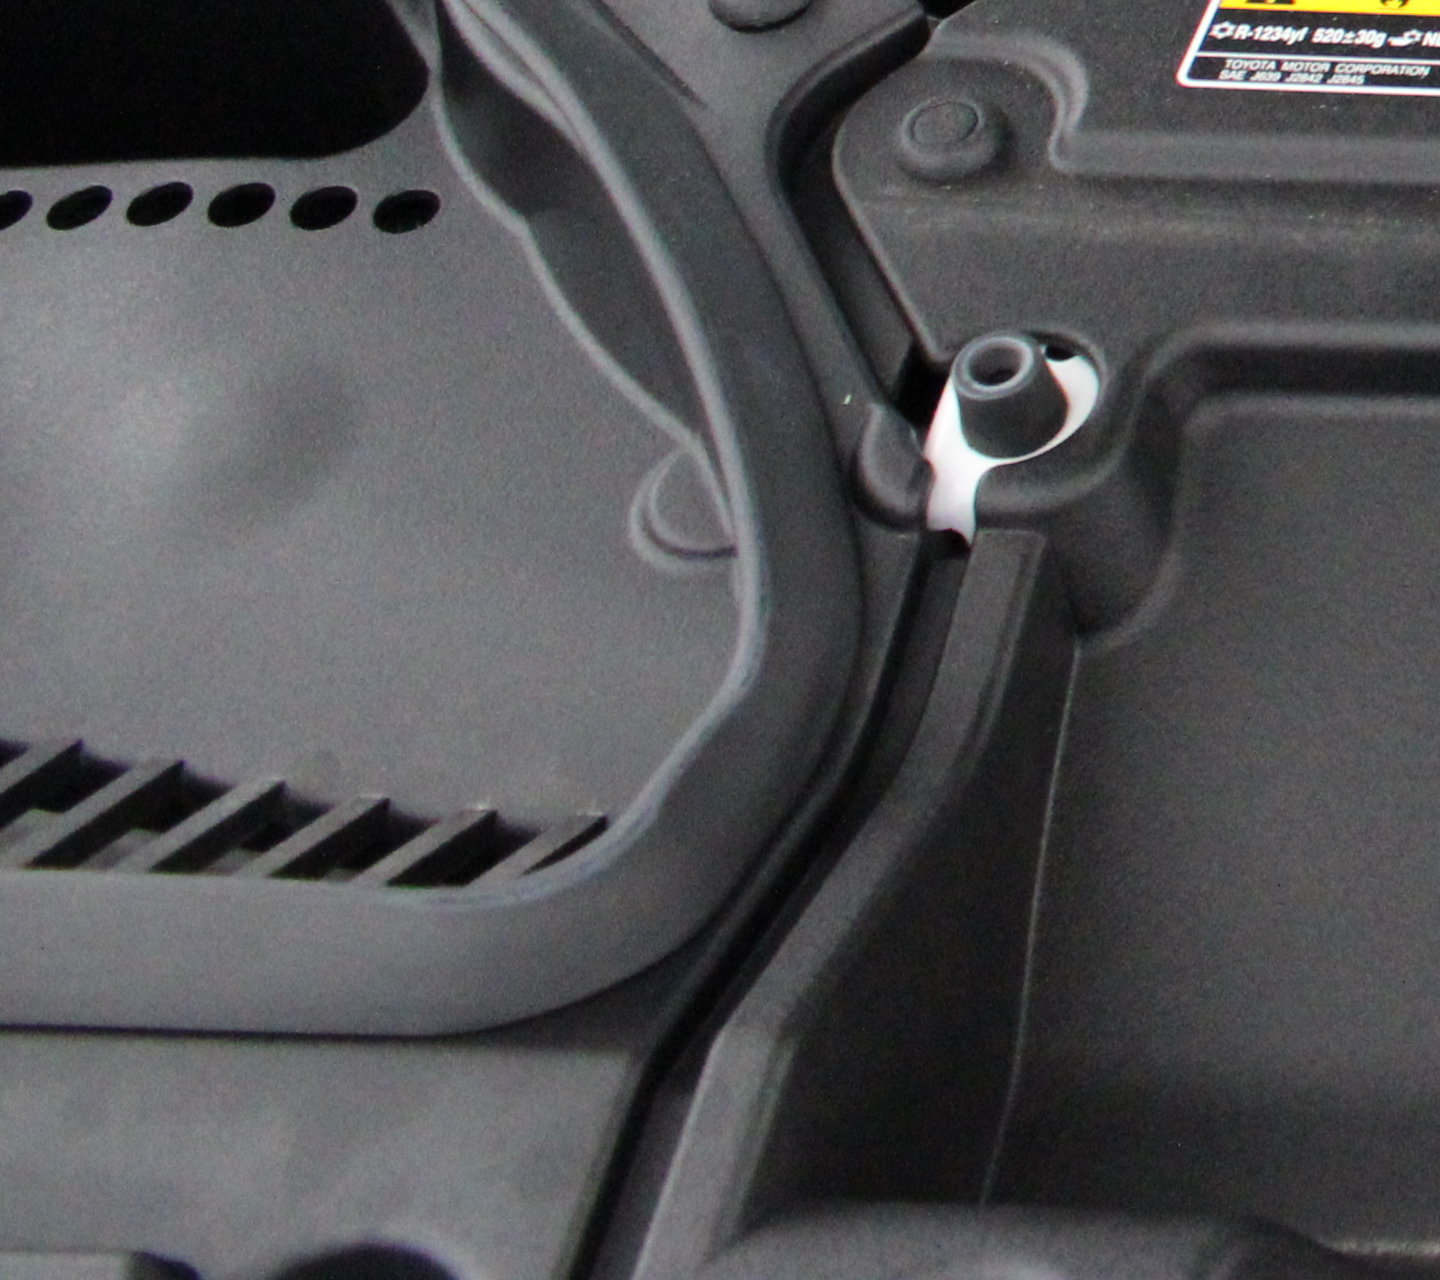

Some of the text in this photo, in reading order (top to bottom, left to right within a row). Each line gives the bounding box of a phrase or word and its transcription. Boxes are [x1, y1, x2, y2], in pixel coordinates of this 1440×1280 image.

[1233, 22, 1308, 43] R-1234yf
[1312, 27, 1388, 48] 520±30g
[1219, 70, 1246, 81] SAE
[1224, 59, 1430, 77] TOYOTA MOTOR CORPORATION
